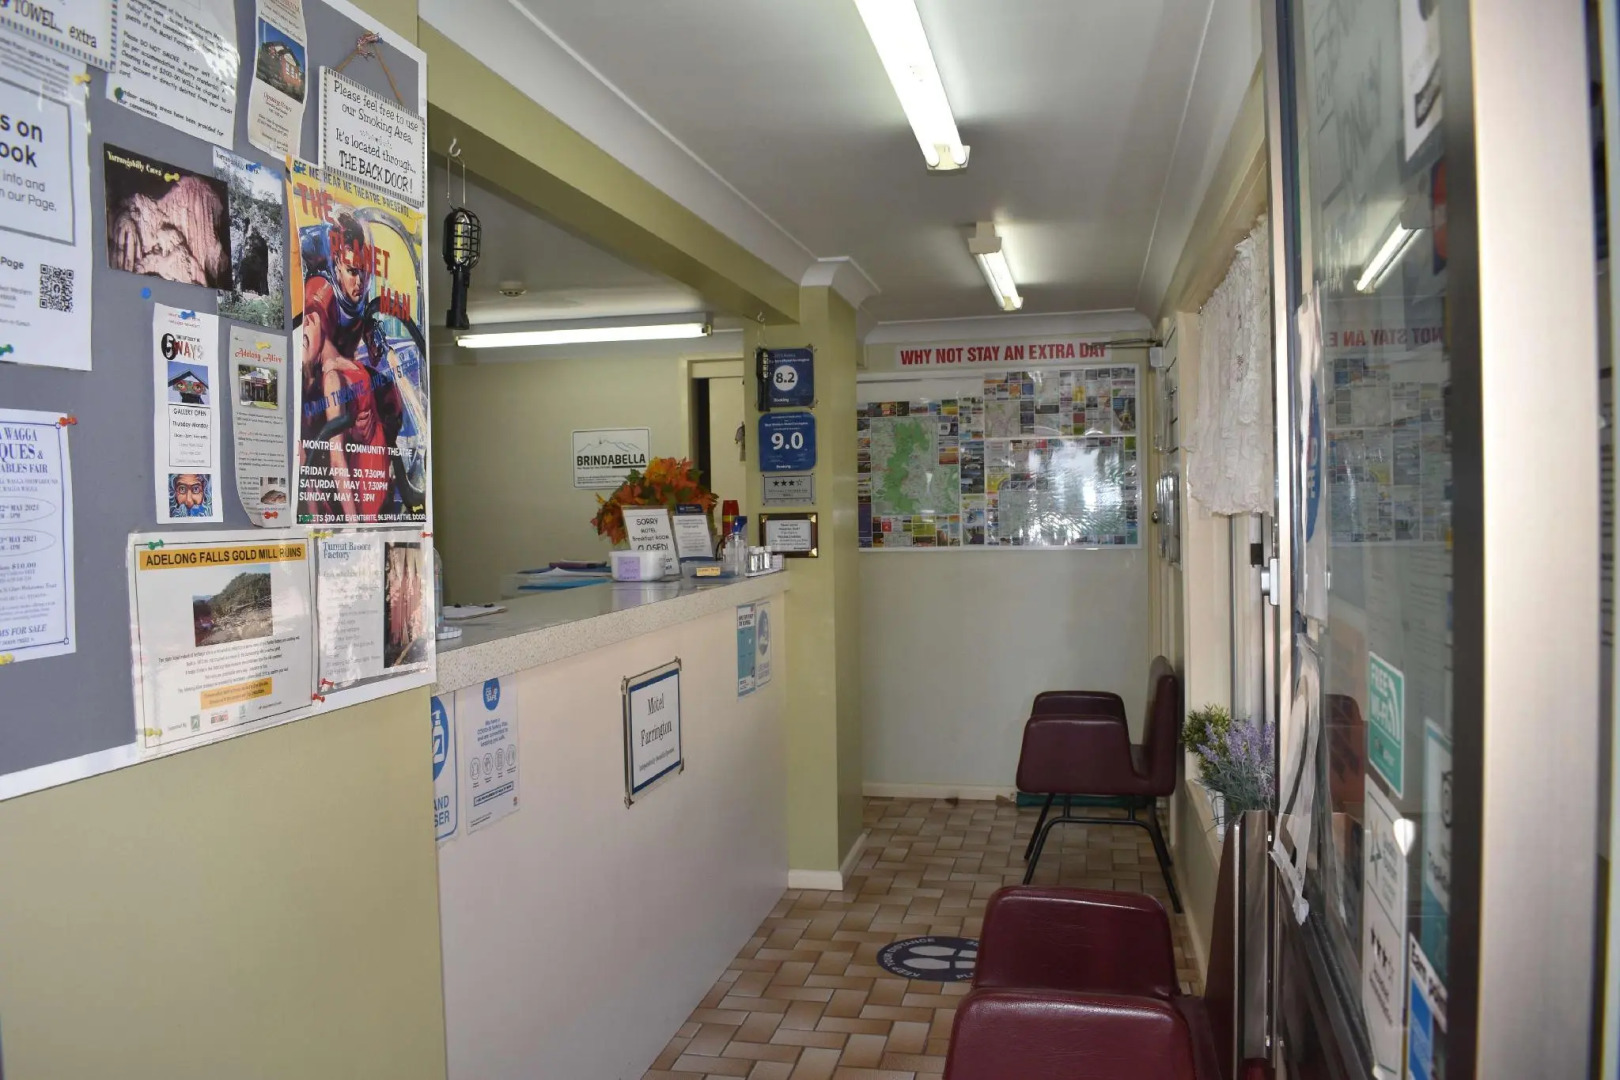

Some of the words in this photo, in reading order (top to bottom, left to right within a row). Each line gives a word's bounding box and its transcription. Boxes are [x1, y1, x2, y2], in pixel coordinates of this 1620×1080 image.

[69, 25, 97, 48] extra
[334, 80, 361, 103] Please
[363, 95, 377, 112] feel
[379, 103, 395, 120] free
[396, 112, 404, 124] to
[406, 119, 418, 132] use
[342, 103, 356, 116] our
[359, 107, 393, 138] Smoking
[17, 120, 43, 143] on
[336, 128, 350, 145] It's
[351, 135, 381, 159] located
[339, 150, 358, 171] THE
[358, 158, 382, 182] BACK
[385, 169, 413, 193] DOOR!
[3, 170, 23, 186] info
[25, 179, 45, 193] and
[323, 172, 342, 189] HEAR
[343, 181, 353, 194] ME
[353, 184, 380, 206] THEATRE
[8, 191, 25, 202] our
[297, 181, 334, 226] THE
[328, 228, 391, 280] PLANET
[1, 256, 24, 270] Page
[379, 285, 412, 324] MAN
[900, 349, 932, 365] WHY
[936, 347, 963, 364] NOT
[967, 345, 1000, 362] STAY
[1003, 344, 1025, 361] AN
[1028, 343, 1076, 360] EXTRA
[1079, 342, 1106, 358] DAY
[775, 372, 795, 384] 8.2
[194, 409, 207, 417] OPEN
[4, 427, 38, 441] WAGGA
[771, 431, 804, 450] 9.0
[37, 450, 43, 460] &
[302, 439, 344, 452] MONTREAL
[345, 443, 386, 456] COMMUNITY
[388, 447, 413, 457] THEATRE
[576, 453, 646, 466] BRINDABELLA
[29, 463, 48, 474] FAIR
[299, 465, 328, 476] FRIDAY
[329, 468, 350, 478] APRIL
[364, 469, 386, 479] 7:30PM
[299, 478, 339, 489] SATURDAY
[343, 481, 360, 490] MAY
[367, 481, 388, 491] 7:30PM
[299, 491, 330, 502] SUNDAY
[333, 493, 351, 502] MAY
[362, 493, 375, 502] 3PM
[336, 514, 345, 522] AT
[636, 517, 658, 526] SORRY
[146, 551, 197, 567] ADELONG
[199, 550, 230, 563] FALLS
[232, 549, 256, 561] GOLD
[259, 548, 277, 560] MILL
[279, 547, 302, 558] RUINS
[323, 549, 350, 561] Factory
[11, 626, 27, 636] FOR
[28, 623, 47, 634] SALE
[647, 692, 665, 716] Motel
[640, 720, 672, 747] Farrington
[886, 937, 936, 953] DISTANCE
[892, 966, 921, 978] KEEP
